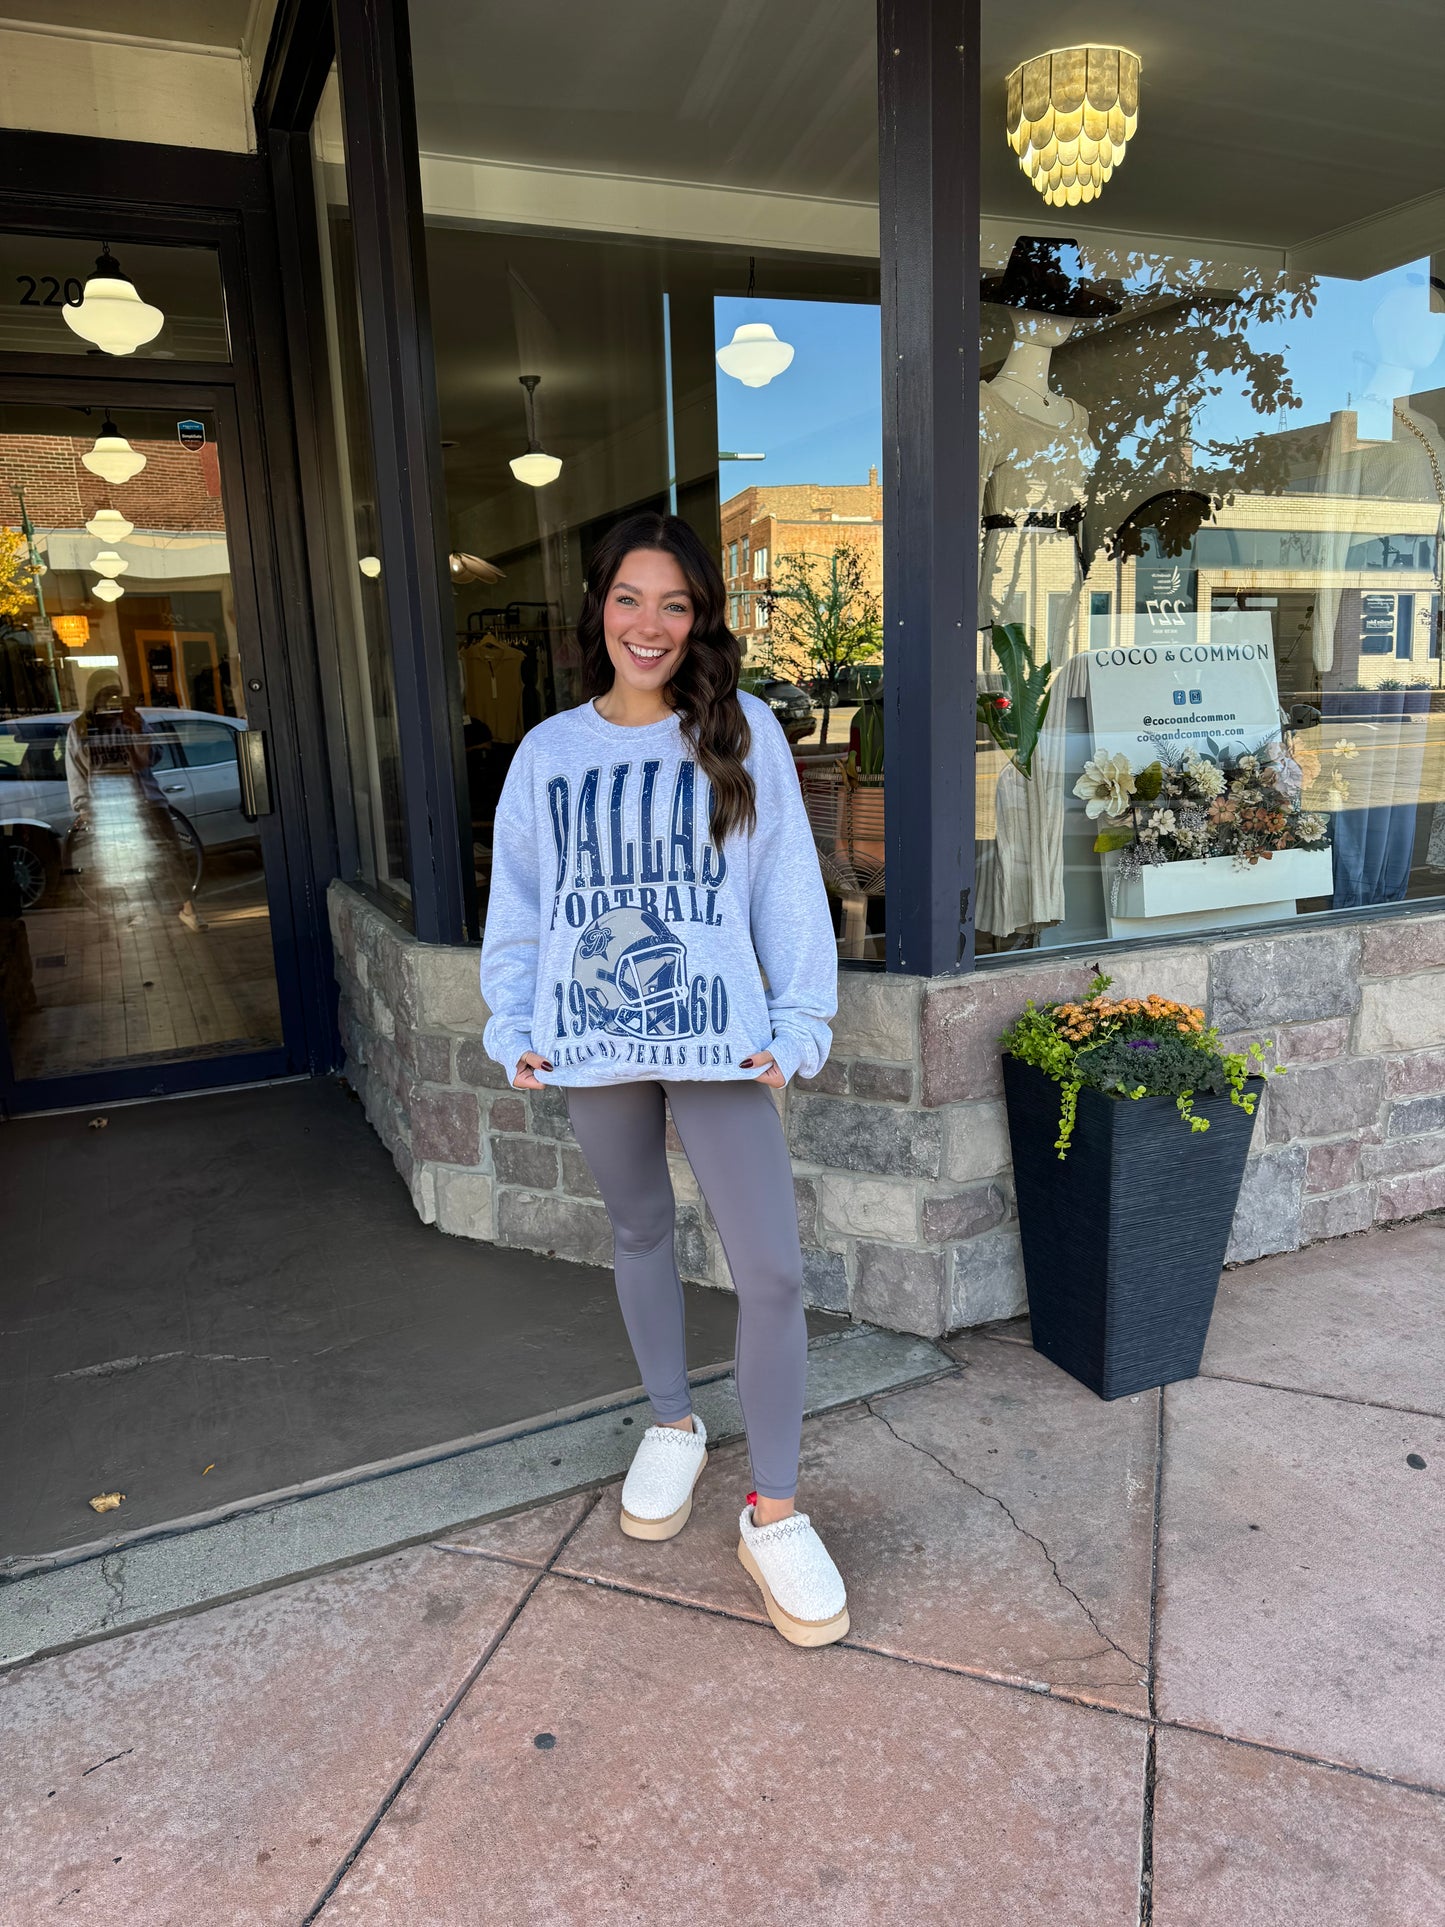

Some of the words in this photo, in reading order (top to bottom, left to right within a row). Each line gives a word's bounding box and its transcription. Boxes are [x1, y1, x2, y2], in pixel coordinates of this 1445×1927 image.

[16, 275, 84, 308] 220
[1095, 648, 1158, 667] COCO
[1165, 650, 1175, 662] &
[1180, 644, 1269, 663] COMMON
[1143, 712, 1236, 726] @cocoandcommon
[1136, 727, 1245, 743] cocoandcommon.com
[627, 1043, 687, 1066] TEXAS
[698, 1044, 733, 1066] USA
